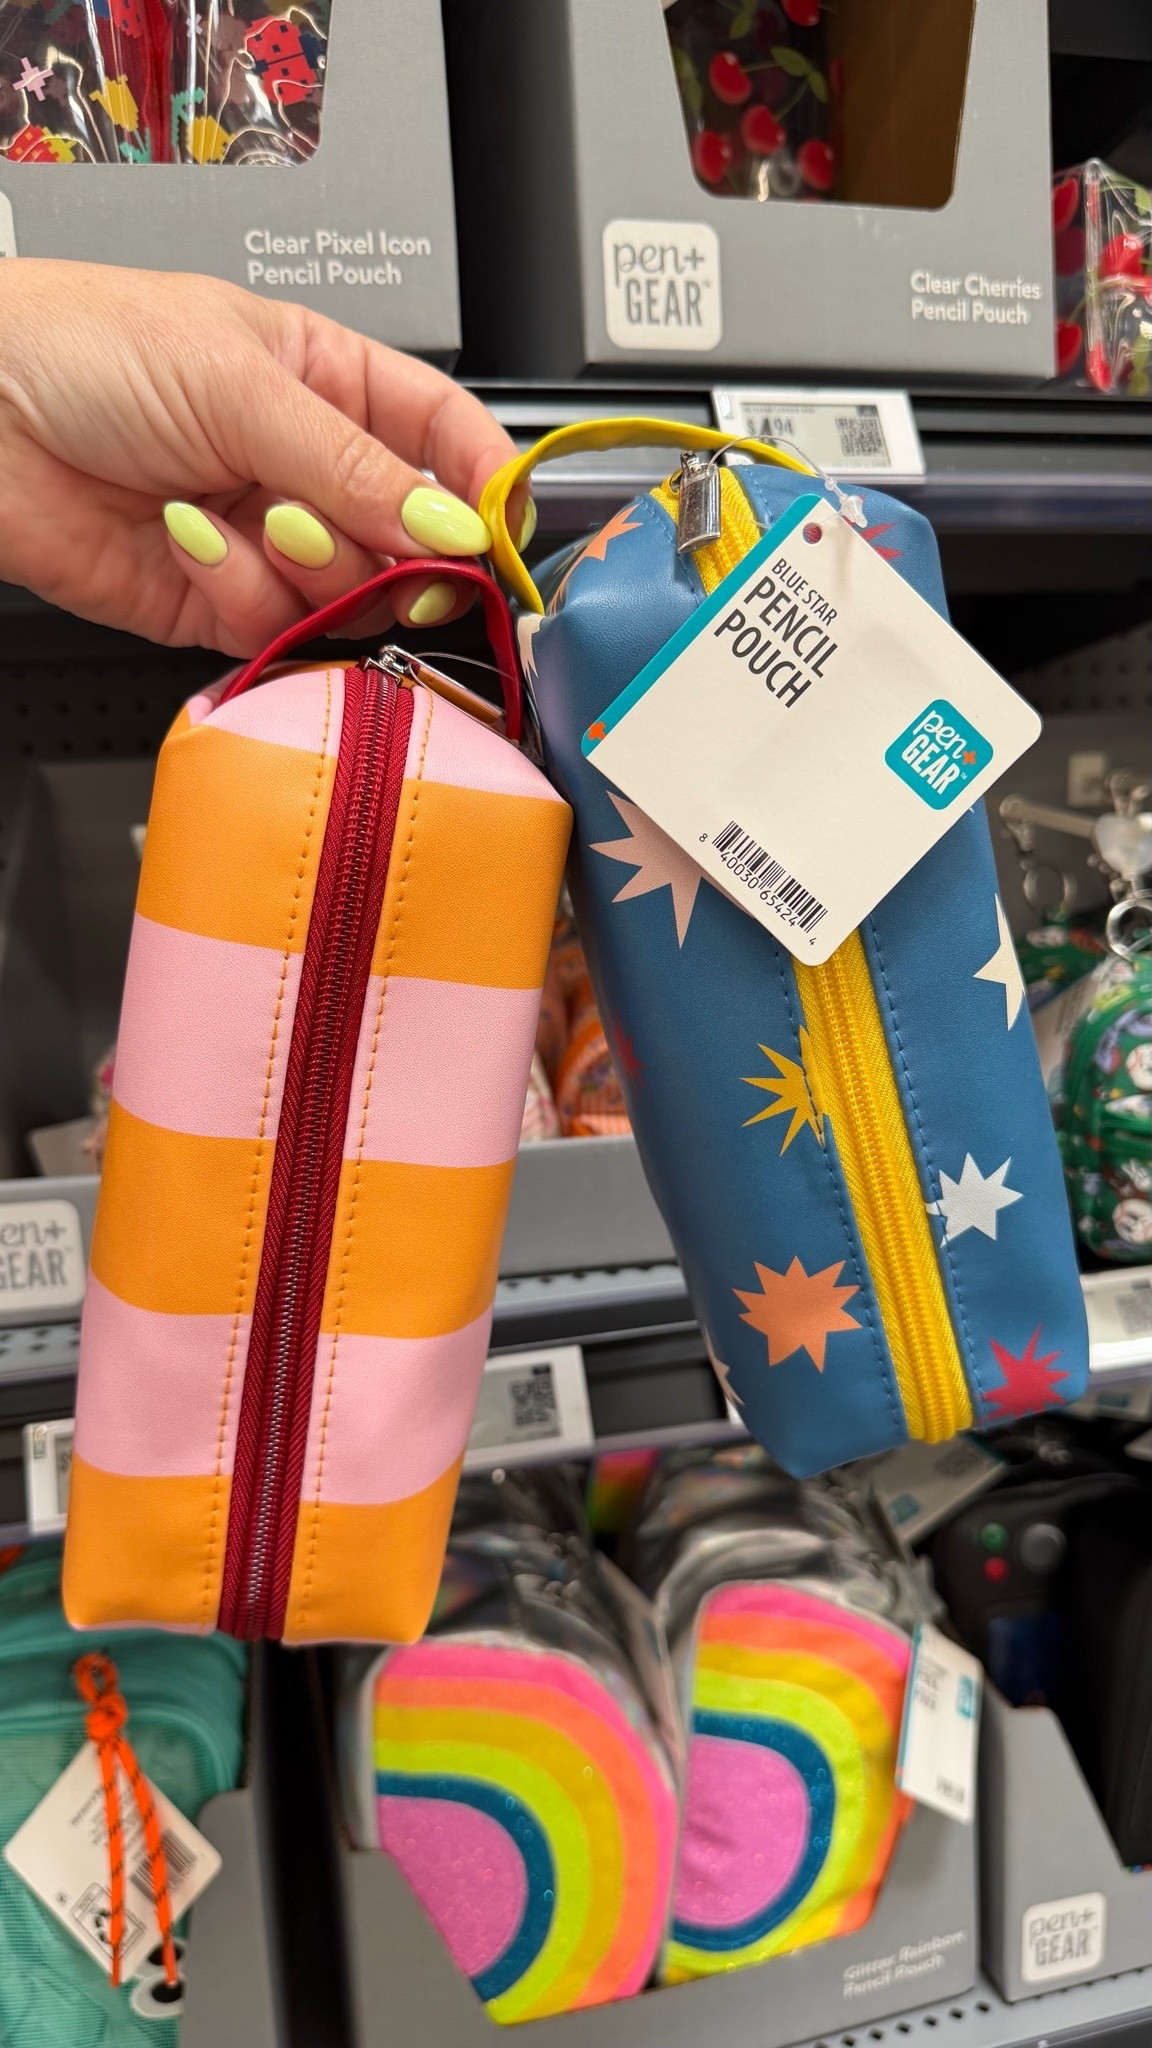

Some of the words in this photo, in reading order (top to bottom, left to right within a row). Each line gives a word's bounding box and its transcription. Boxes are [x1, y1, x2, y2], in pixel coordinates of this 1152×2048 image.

[244, 229, 310, 255] Clear
[316, 230, 374, 256] Pixel
[379, 230, 432, 256] Icon
[248, 259, 321, 286] Pencil
[327, 260, 402, 286] Pouch
[910, 268, 961, 295] Clear
[964, 272, 1042, 300] Cherries
[625, 278, 702, 327] GEAR
[911, 296, 966, 322] Pencil
[972, 300, 1030, 325] Pouch
[771, 557, 809, 597] BLUE
[802, 589, 838, 627] STAR
[743, 575, 839, 679] PENCIL
[713, 608, 813, 709] POUCH
[698, 833, 708, 843] 8
[719, 850, 761, 890] 40030
[759, 889, 800, 928] 65424
[808, 937, 817, 946] 4
[0, 1220, 67, 1247] en+
